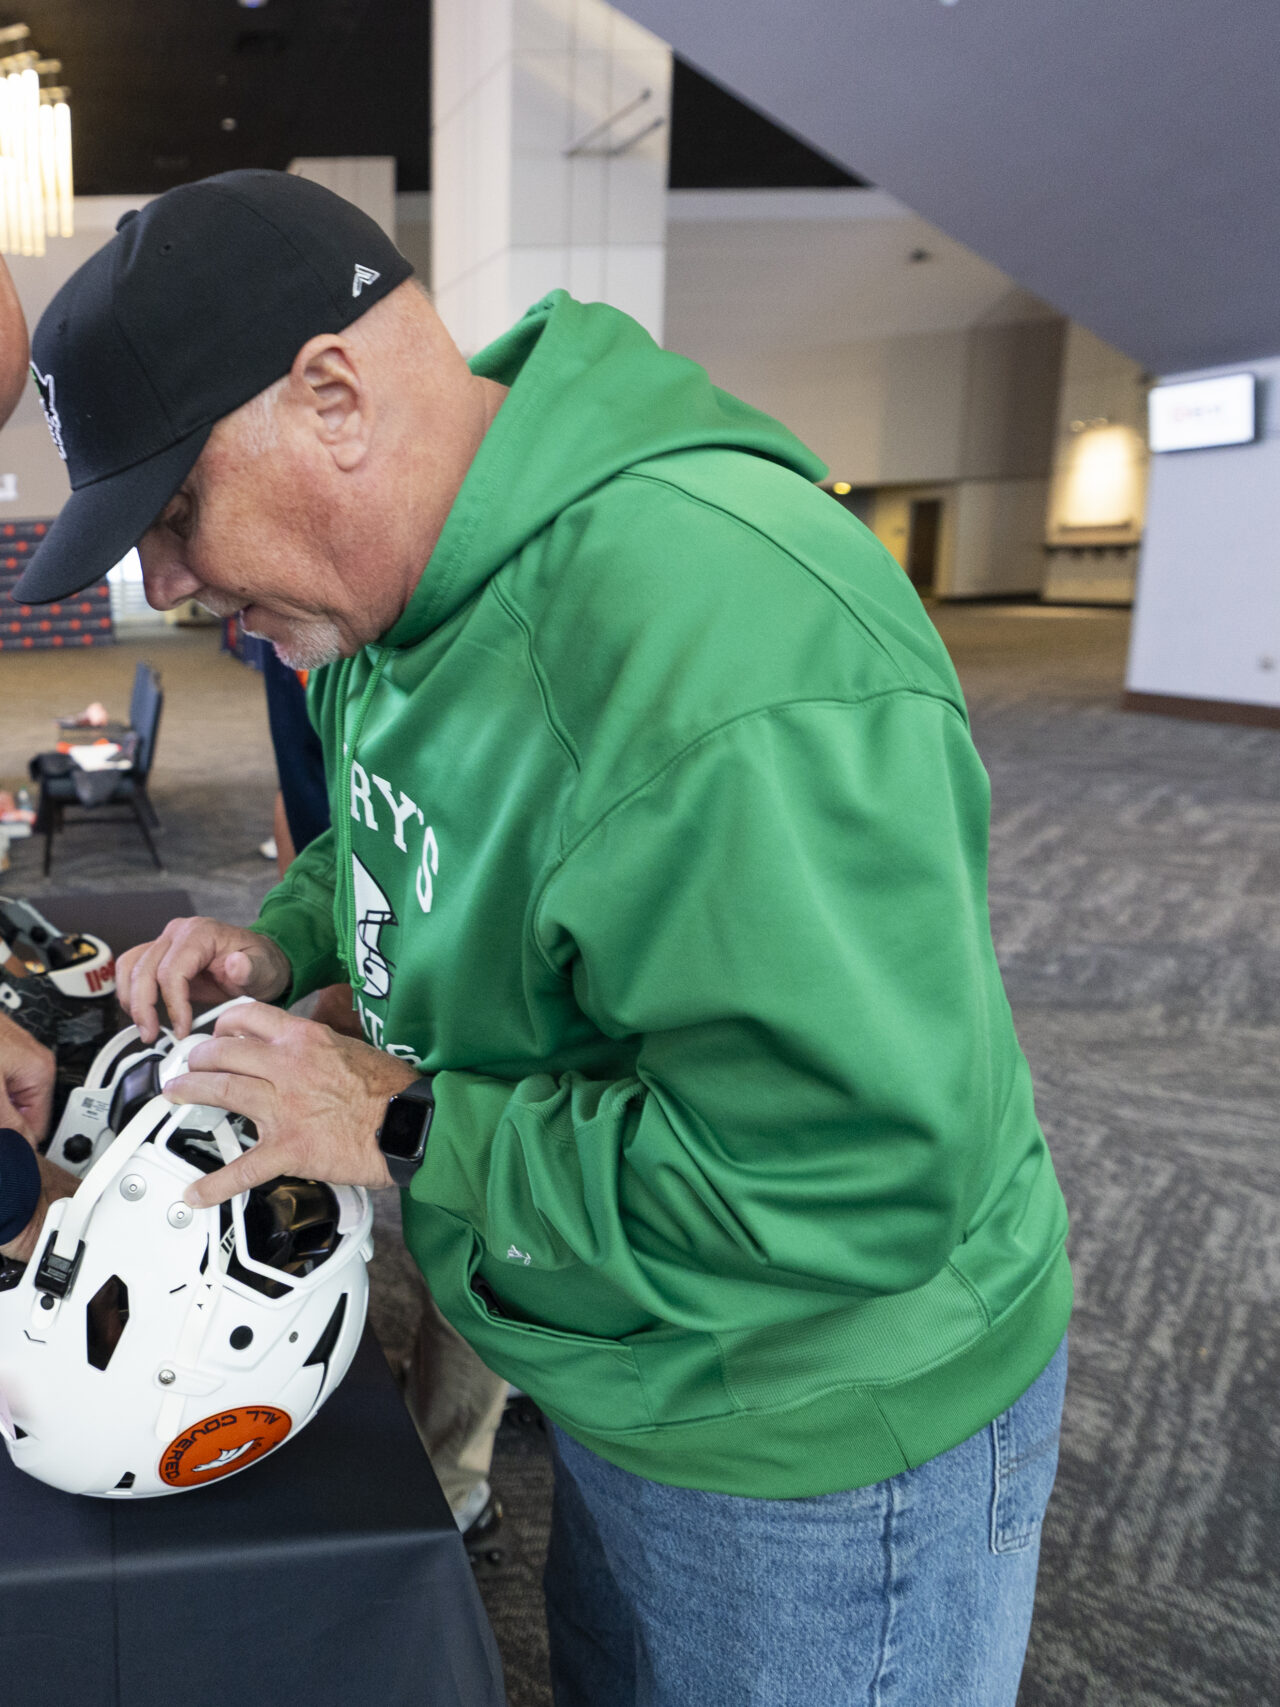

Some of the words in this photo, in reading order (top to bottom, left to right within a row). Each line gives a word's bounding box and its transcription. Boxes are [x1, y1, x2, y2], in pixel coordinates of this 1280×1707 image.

[344, 743, 439, 913] RY'S
[165, 1414, 237, 1481] COVERED
[246, 1410, 281, 1425] ALL
